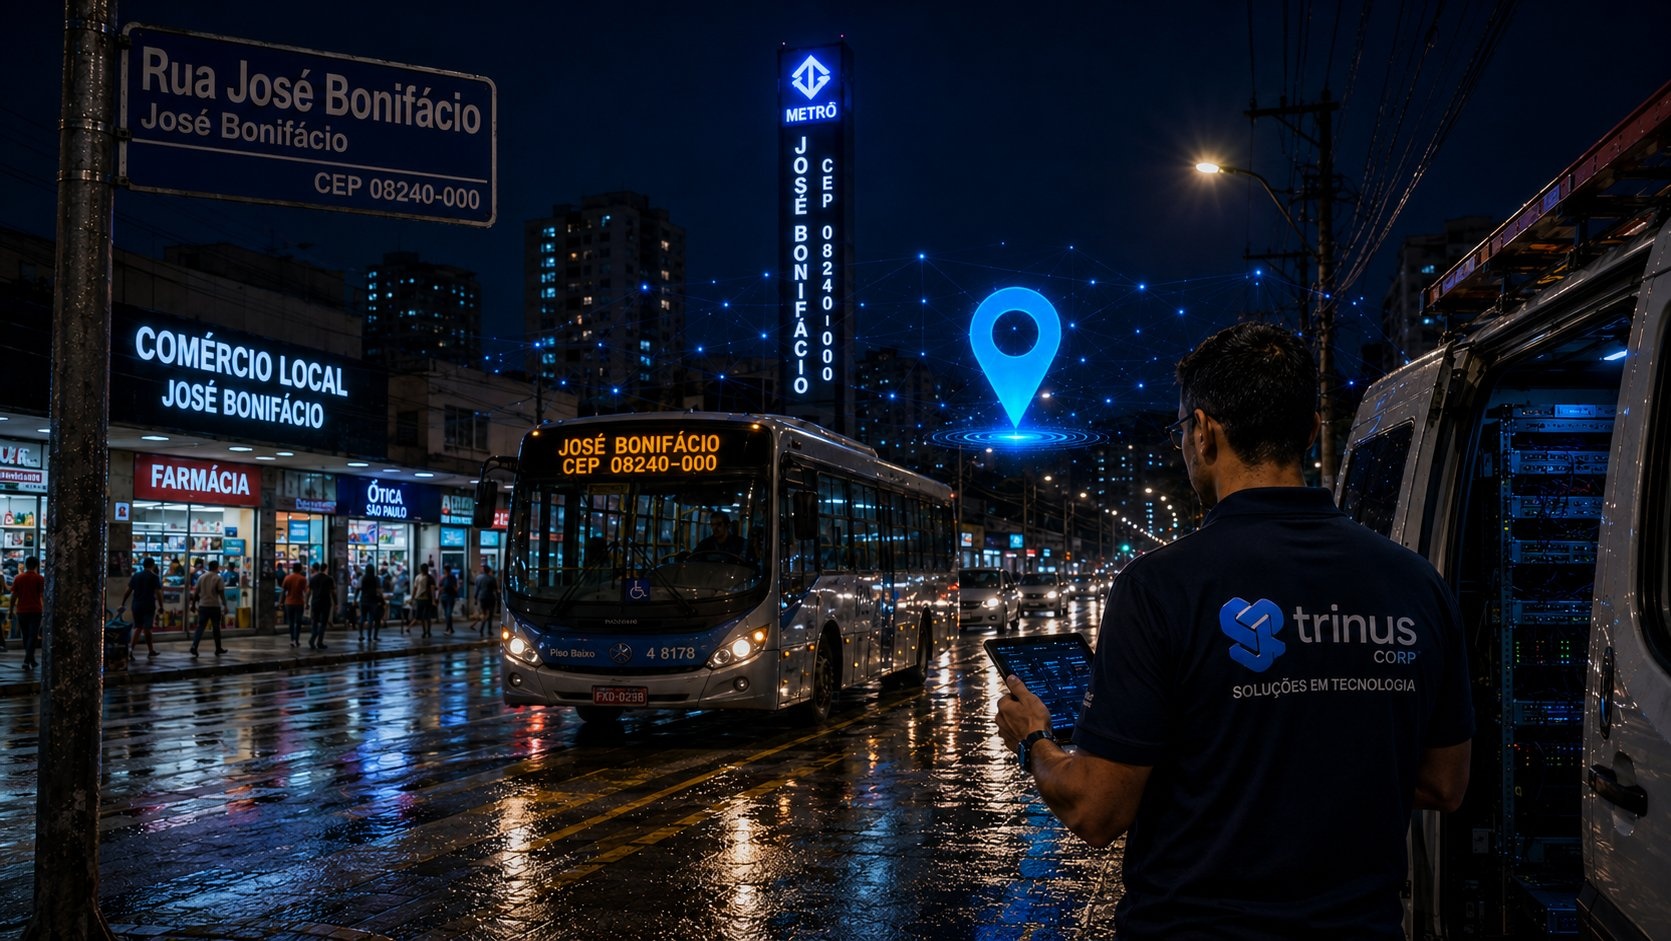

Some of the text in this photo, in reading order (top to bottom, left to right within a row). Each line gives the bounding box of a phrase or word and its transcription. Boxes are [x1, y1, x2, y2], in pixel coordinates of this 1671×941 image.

[142, 46, 481, 135] Rua José Bonifácio
[786, 102, 837, 122] METRÔ
[141, 103, 348, 153] José Bonifácio
[314, 172, 480, 209] CEP 08240-000
[794, 136, 808, 394] JOSÉ BONIFÁCIO
[822, 158, 833, 381] CEP 08240-000
[135, 326, 348, 397] COMÉRCIO LOCAL
[162, 379, 324, 429] JOSÉ BONIFÁCIO
[558, 431, 720, 457] JOSÉ BONIFÁCIO
[562, 455, 717, 475] CEP 08240-000
[151, 464, 250, 496] FARMÁCIA
[367, 479, 403, 505] ÓTICA
[383, 505, 407, 519] PAULO
[1293, 604, 1417, 646] trinus
[550, 648, 595, 658] Piso Baixo
[646, 647, 696, 660] 4 8178
[1374, 650, 1417, 664] CORP
[1233, 678, 1416, 699] SOLUÇÕES EM TECNOLOGIA
